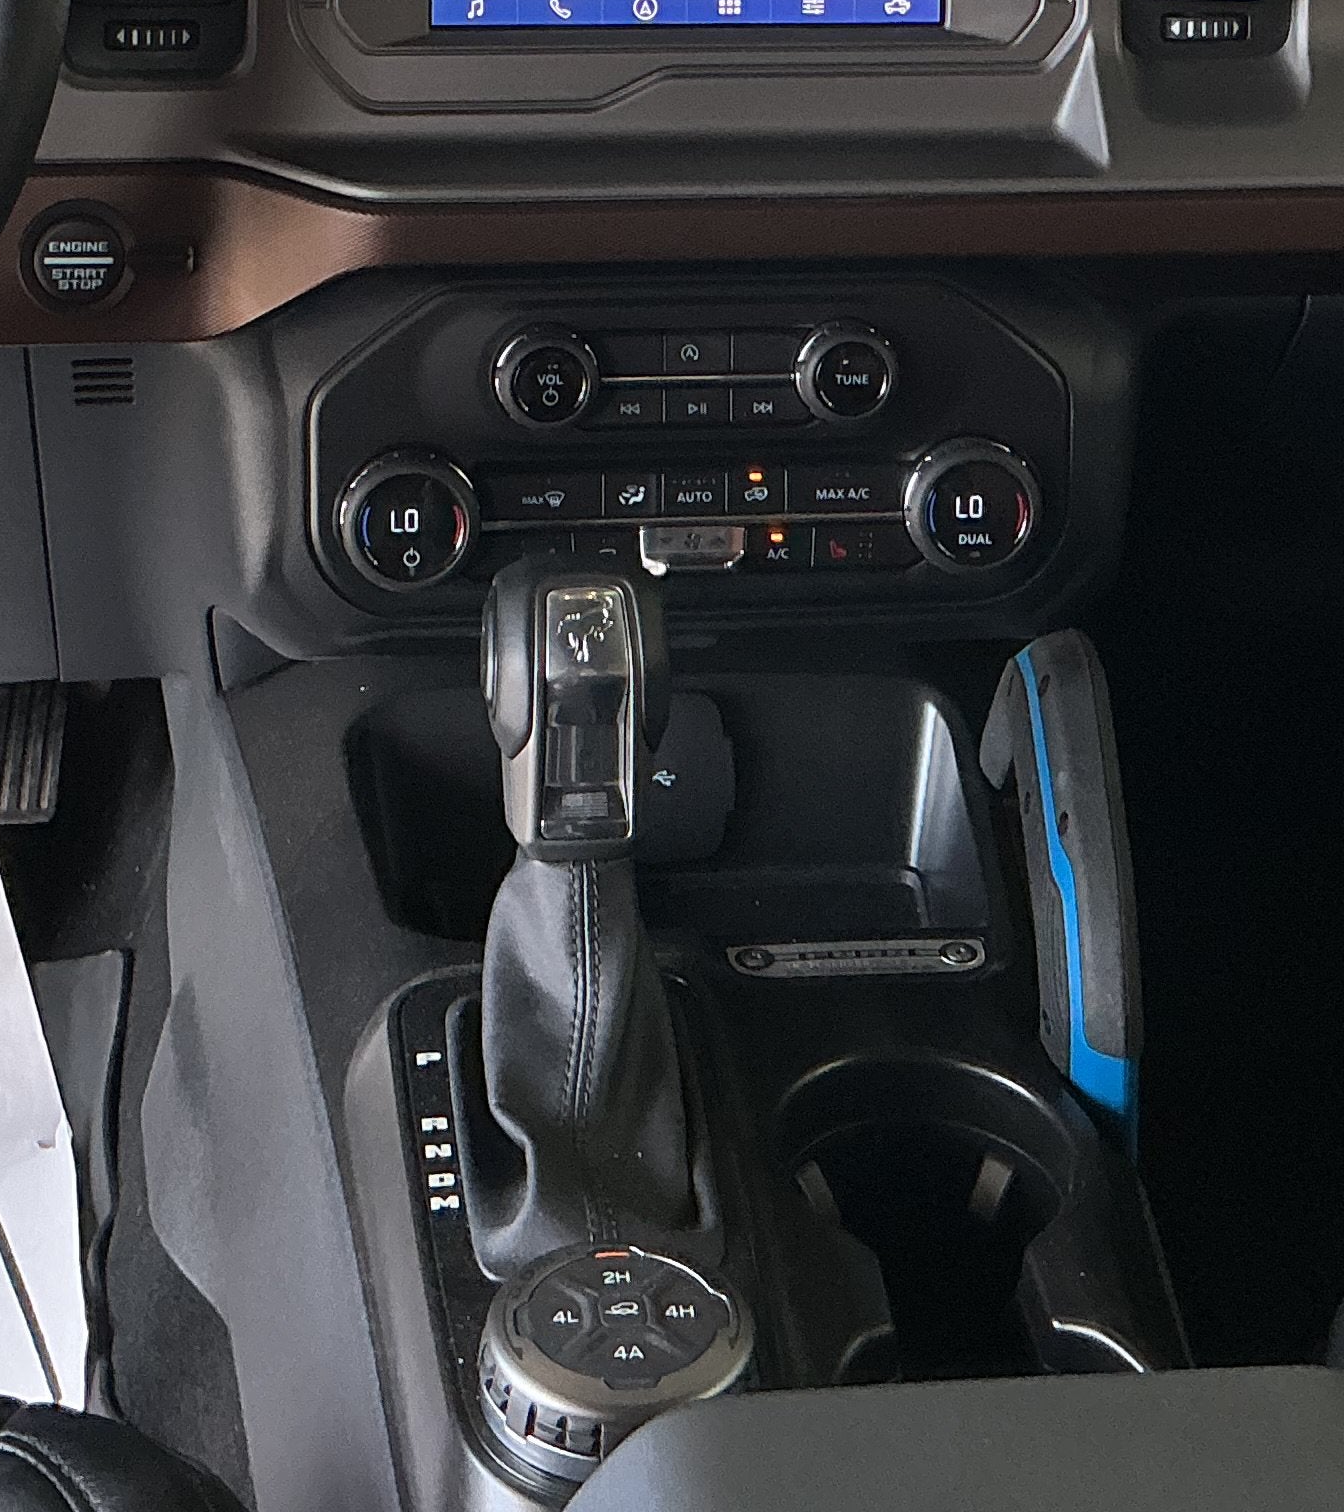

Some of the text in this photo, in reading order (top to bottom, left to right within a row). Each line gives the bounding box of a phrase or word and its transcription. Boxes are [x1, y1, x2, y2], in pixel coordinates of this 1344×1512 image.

[48, 241, 109, 253] ENGINE
[51, 268, 106, 280] START
[58, 279, 103, 291] STOP
[536, 372, 564, 387] VOL
[834, 373, 870, 387] TUNE
[676, 490, 713, 504] AUTO
[815, 488, 871, 501] MAX A/C
[955, 495, 983, 519] LO
[389, 509, 420, 535] LO
[958, 533, 992, 546] DUAL
[766, 547, 790, 561] A/C
[416, 1051, 443, 1067] P
[425, 1143, 452, 1160] N
[428, 1172, 455, 1189] D
[430, 1194, 460, 1210] M
[602, 1271, 631, 1285] 2H
[552, 1310, 579, 1324] 4L
[665, 1305, 695, 1320] 4H
[613, 1345, 645, 1361] 4A
